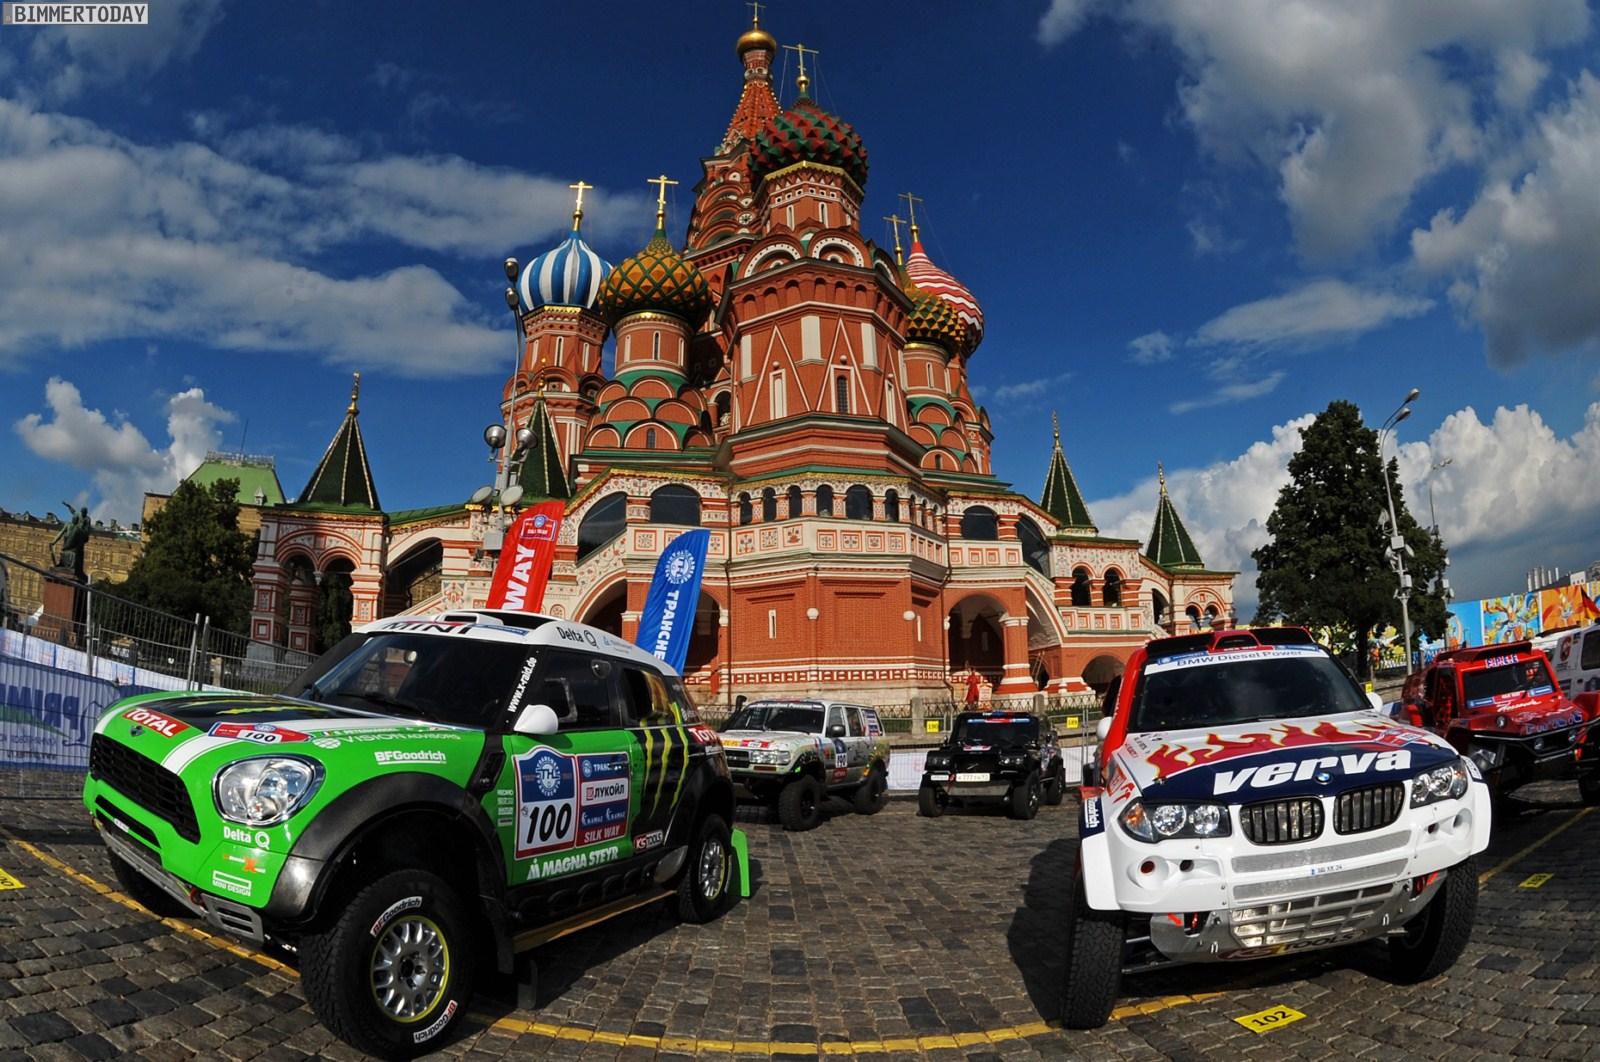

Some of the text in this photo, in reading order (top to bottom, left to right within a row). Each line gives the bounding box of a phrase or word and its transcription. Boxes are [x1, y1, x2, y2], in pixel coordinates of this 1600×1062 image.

[501, 543, 536, 611] WAY
[382, 622, 472, 634] MINI
[556, 626, 584, 642] Delta
[583, 629, 600, 650] Q
[1177, 656, 1214, 667] BMW
[1217, 651, 1260, 662] Diesel
[1263, 649, 1302, 658] Power
[507, 657, 537, 713] www.x-raid.de
[126, 707, 178, 737] TOTAL
[928, 722, 939, 731] 190
[244, 731, 276, 743] 100
[341, 733, 408, 743] VISION
[374, 750, 447, 763] BFGoodrich
[1213, 750, 1412, 796] verva
[594, 782, 625, 798] ЛУКОЙЛ
[526, 802, 572, 845] 100
[223, 825, 270, 850] Delta Q
[584, 824, 621, 843] SILK WAY
[636, 831, 662, 849] KS TOOLS
[541, 846, 619, 878] MAGNA STEYR
[212, 879, 252, 897] MINI DESIGN
[372, 897, 421, 936] BFGoodrich
[1283, 934, 1355, 950] TOOLS
[414, 1002, 456, 1042] BFGoodrich
[1251, 1010, 1292, 1027] 102
